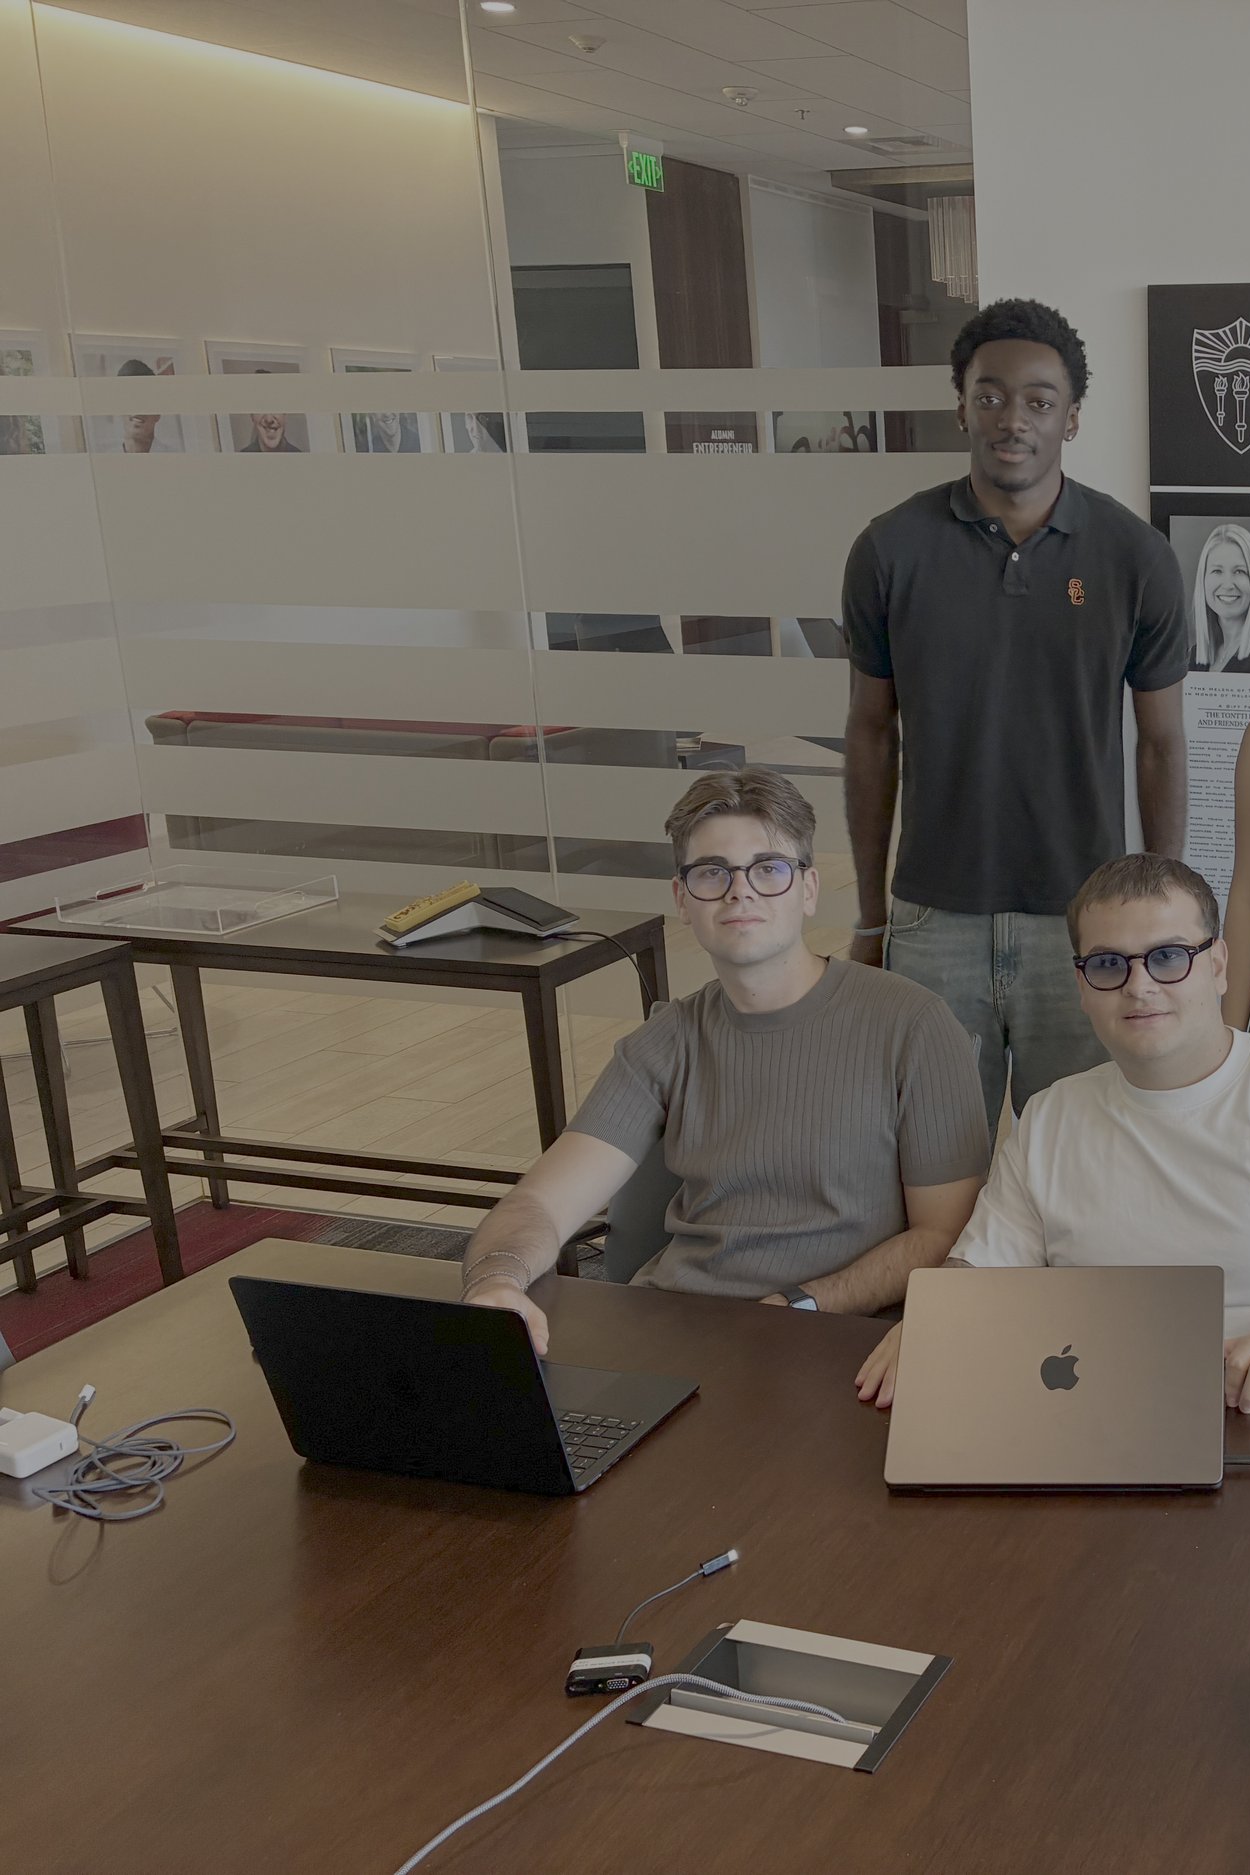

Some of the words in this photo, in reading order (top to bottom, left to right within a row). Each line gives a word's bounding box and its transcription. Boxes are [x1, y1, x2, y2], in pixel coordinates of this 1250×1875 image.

[632, 151, 657, 187] EXIT
[711, 430, 735, 440] ALUMNI
[692, 442, 753, 454] ENTREPRENEUR
[1214, 719, 1244, 727] FRIENDS
